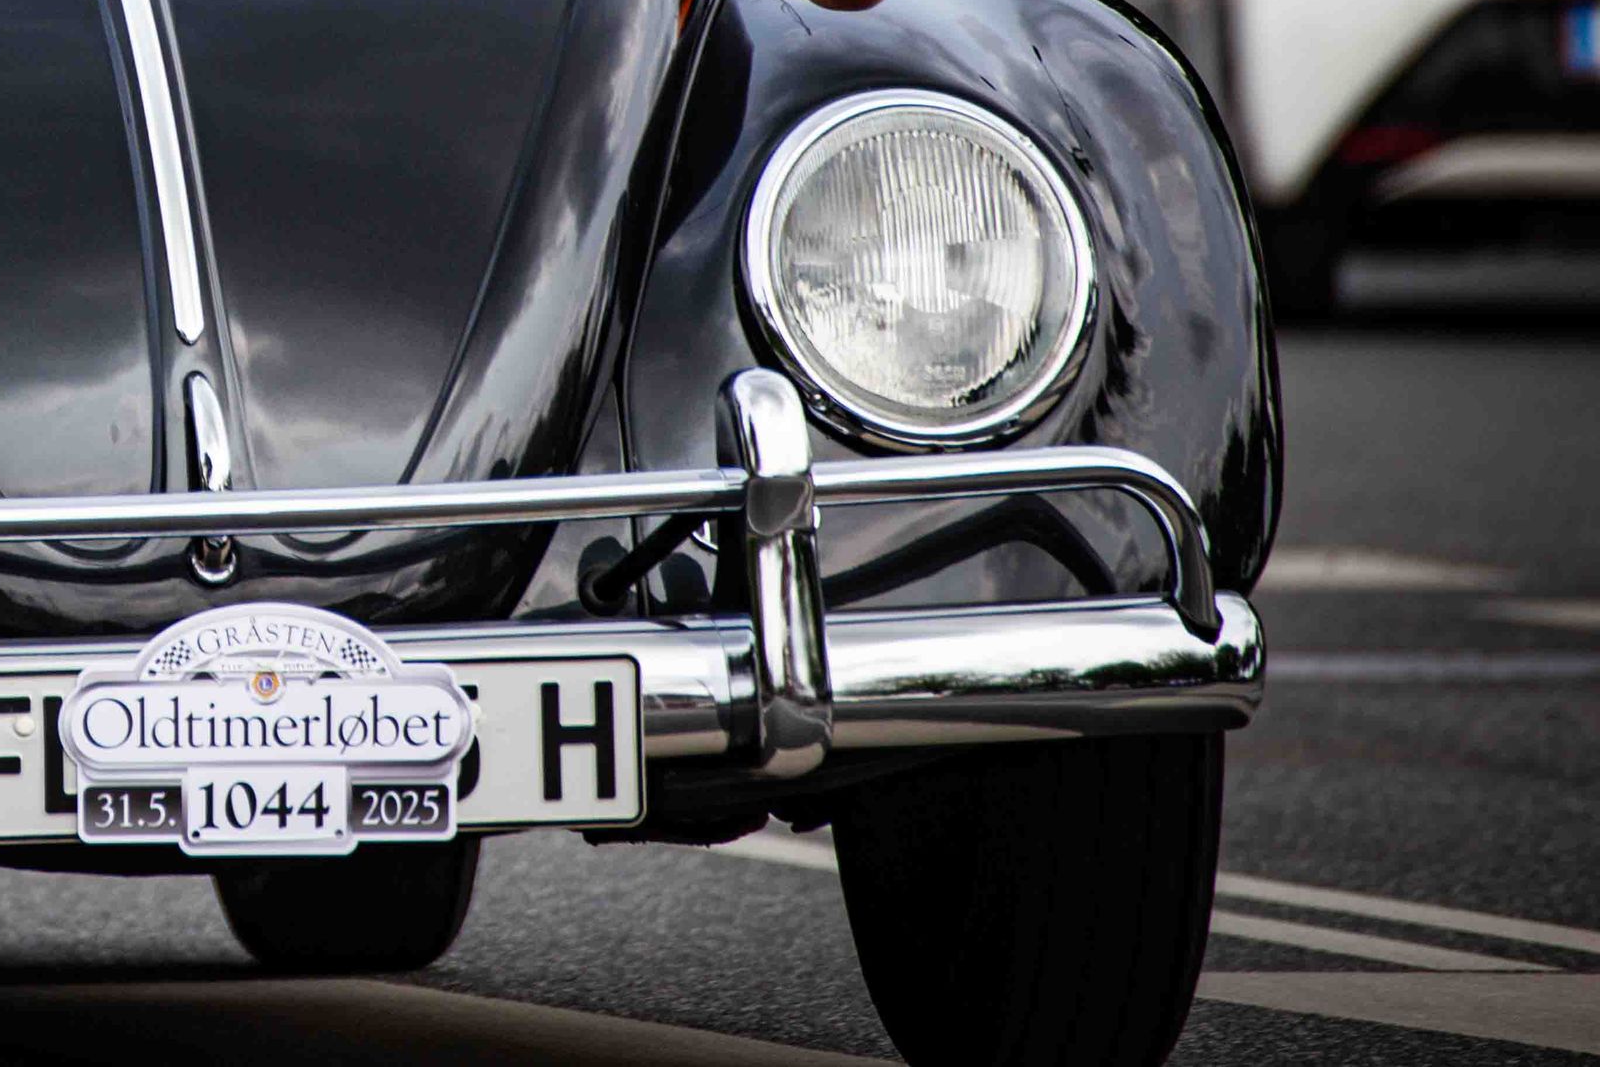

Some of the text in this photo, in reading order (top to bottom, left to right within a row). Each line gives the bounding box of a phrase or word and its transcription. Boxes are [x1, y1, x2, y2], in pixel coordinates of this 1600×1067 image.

[196, 615, 336, 655] GRÅSTEN
[82, 694, 451, 755] Oldtimerløbet
[94, 791, 177, 828] 31.5.
[198, 780, 331, 830] 1044
[361, 788, 440, 826] 2025
